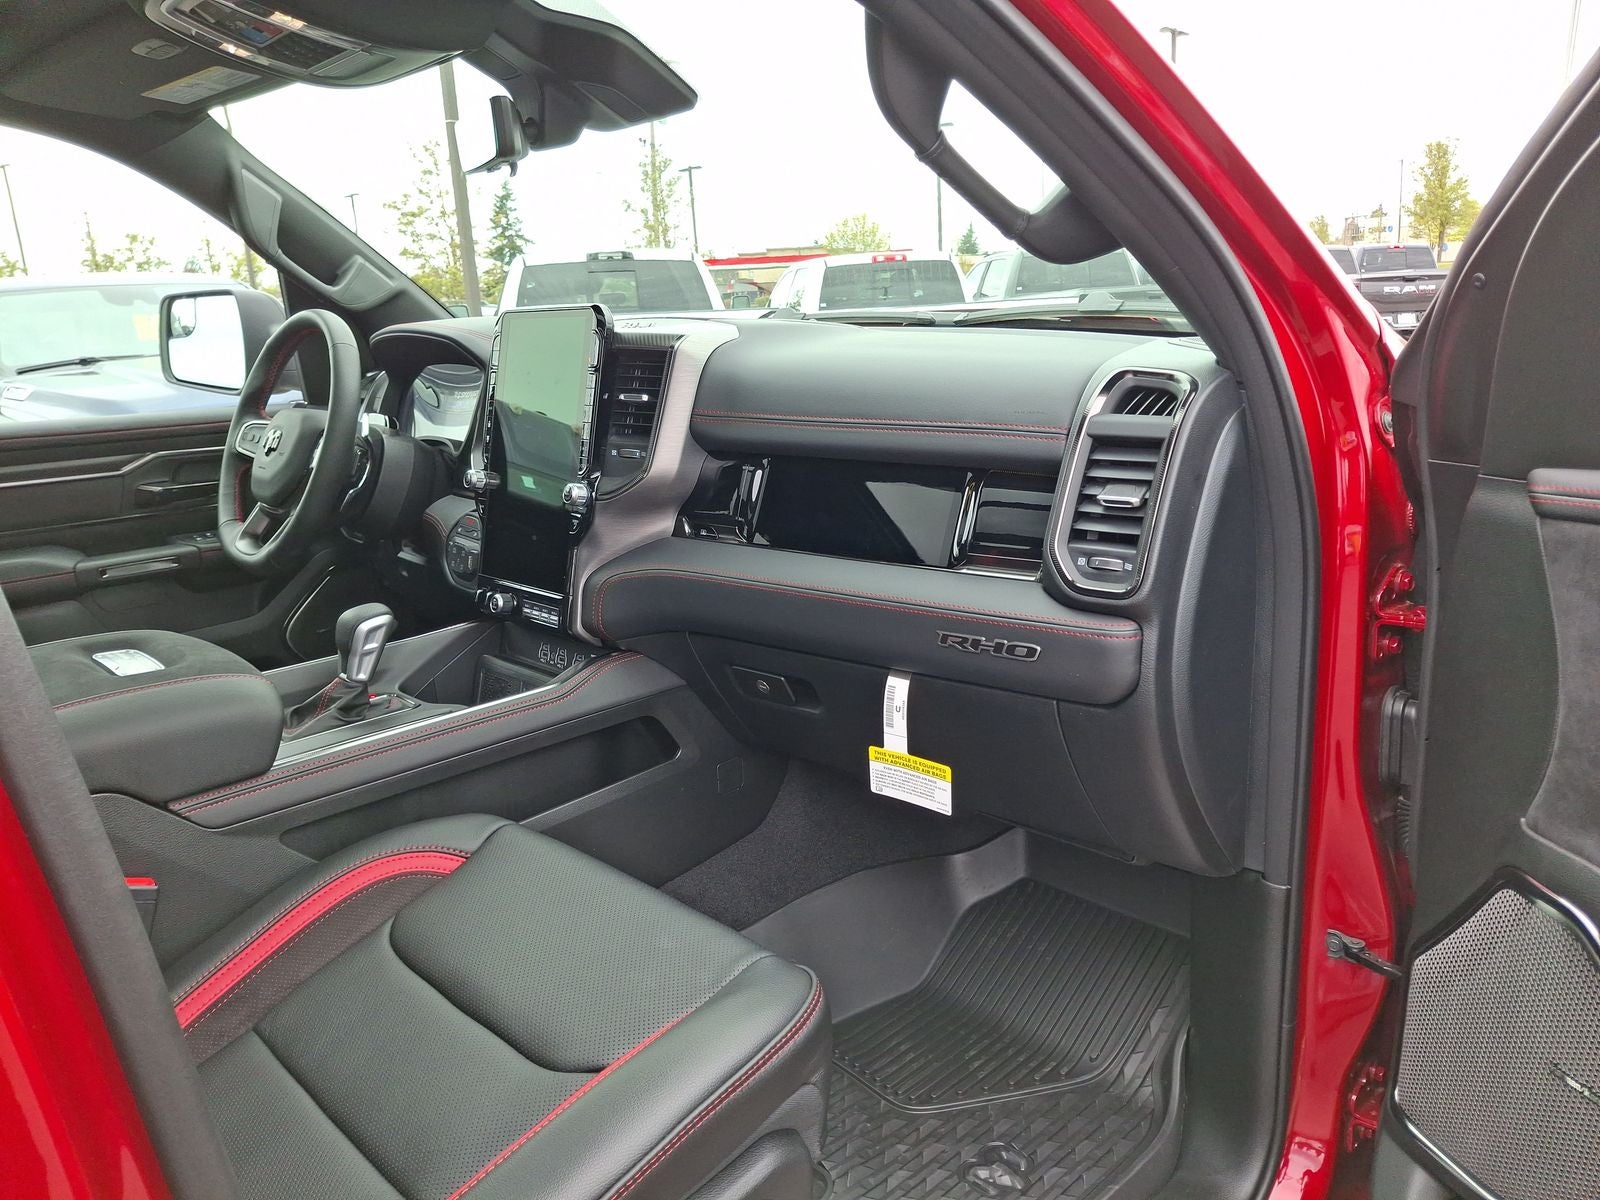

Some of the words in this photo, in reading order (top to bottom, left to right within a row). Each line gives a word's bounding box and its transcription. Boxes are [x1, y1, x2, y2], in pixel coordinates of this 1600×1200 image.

[1383, 284, 1436, 295] RAM
[936, 630, 1041, 661] RHO
[888, 753, 911, 763] VEHICLE
[919, 761, 947, 774] EQUIPPED
[890, 760, 921, 772] ADVANCED
[931, 771, 947, 779] BAGS
